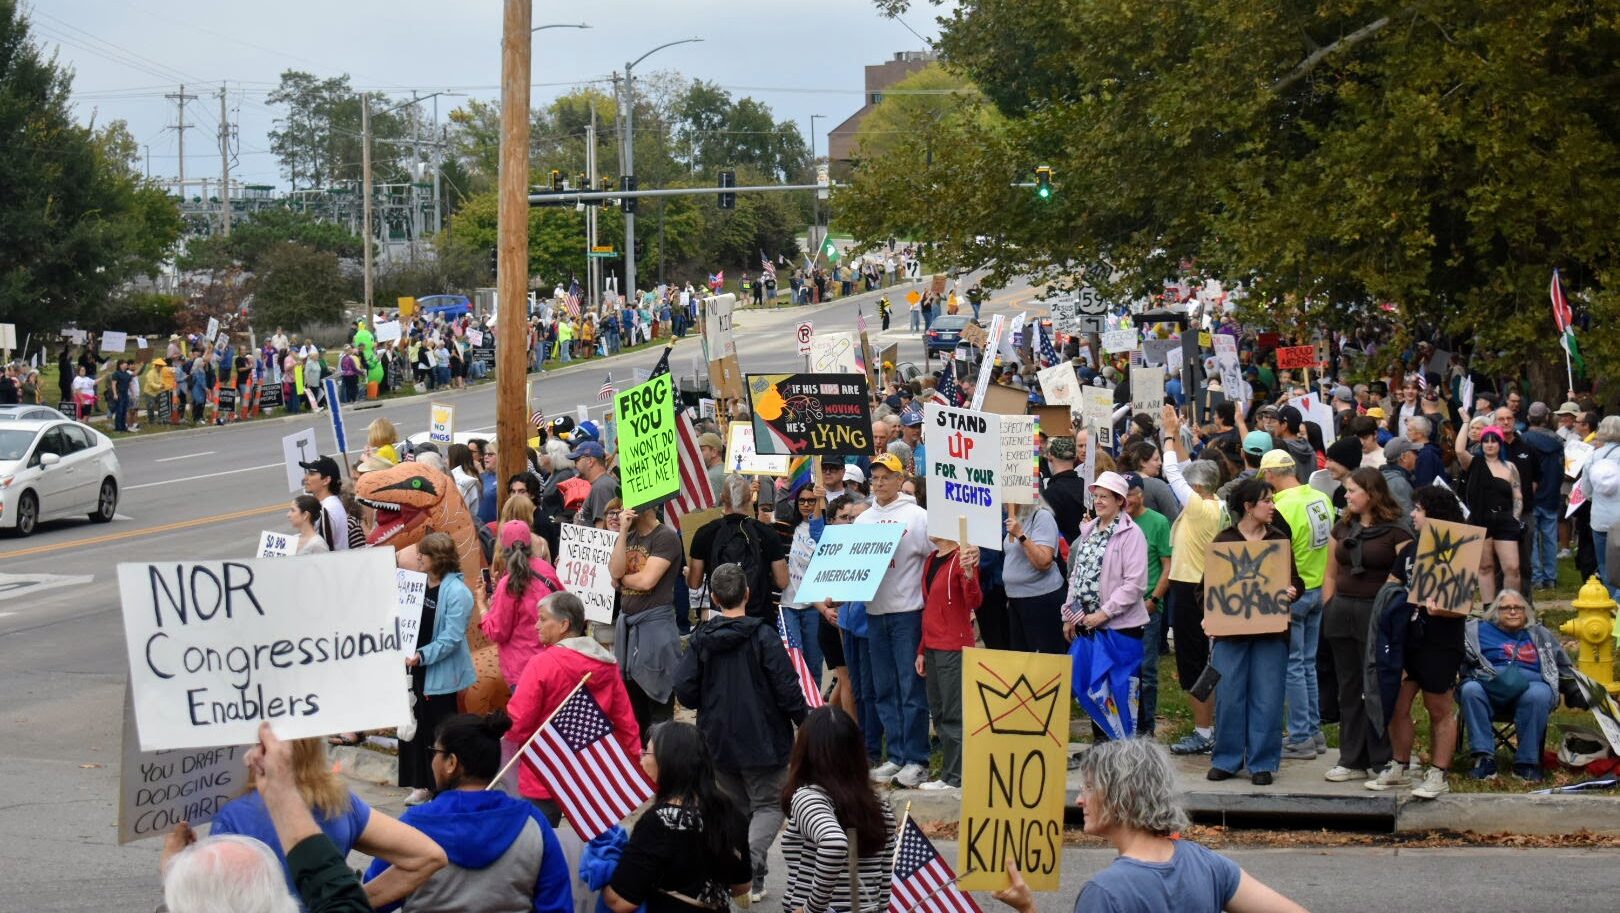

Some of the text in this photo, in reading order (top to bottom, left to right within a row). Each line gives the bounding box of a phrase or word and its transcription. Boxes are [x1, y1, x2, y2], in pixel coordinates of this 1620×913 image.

[707, 299, 718, 317] NO
[1051, 303, 1074, 312] Jesus
[1082, 291, 1104, 308] 59
[619, 379, 667, 420] FROG
[802, 384, 819, 395] HIS
[820, 384, 840, 395] LIPS
[841, 384, 860, 395] ARE
[824, 404, 861, 415] MOVING
[434, 423, 445, 431] NO
[630, 408, 662, 438] YOU
[936, 411, 987, 434] STAND
[1000, 421, 1034, 434] ESPECT MY
[430, 433, 450, 442] KINGS
[629, 433, 660, 458] WONT
[661, 428, 674, 446] DO
[786, 421, 867, 450] HE'S LYING
[948, 432, 974, 460] UP
[1001, 436, 1032, 446] ISTENCE
[626, 447, 672, 477] WHAT YOU
[1006, 450, 1032, 461] EXPECT
[626, 461, 675, 494] TELL ME!
[935, 462, 995, 486] FOR YOUR
[1005, 464, 1018, 473] MY
[1001, 474, 1033, 488] SISTANCE
[945, 481, 993, 507] RIGHTS
[265, 534, 287, 550] SO BAD
[561, 525, 615, 547] SOME OF YOU
[567, 543, 590, 562] NEVER
[817, 541, 893, 557] STOP HURTING
[564, 561, 598, 589] 1984
[813, 568, 871, 584] AMERICANS
[1410, 563, 1437, 602] NO
[148, 562, 265, 627] NOR
[585, 591, 613, 612] SHOWS
[1206, 584, 1243, 616] NO
[401, 617, 417, 631] GER
[188, 684, 320, 726] Enablers
[141, 746, 239, 783] YOU DRAFT
[136, 770, 232, 807] DODGING
[988, 750, 1046, 809] NO
[966, 816, 1060, 875] KINGS
